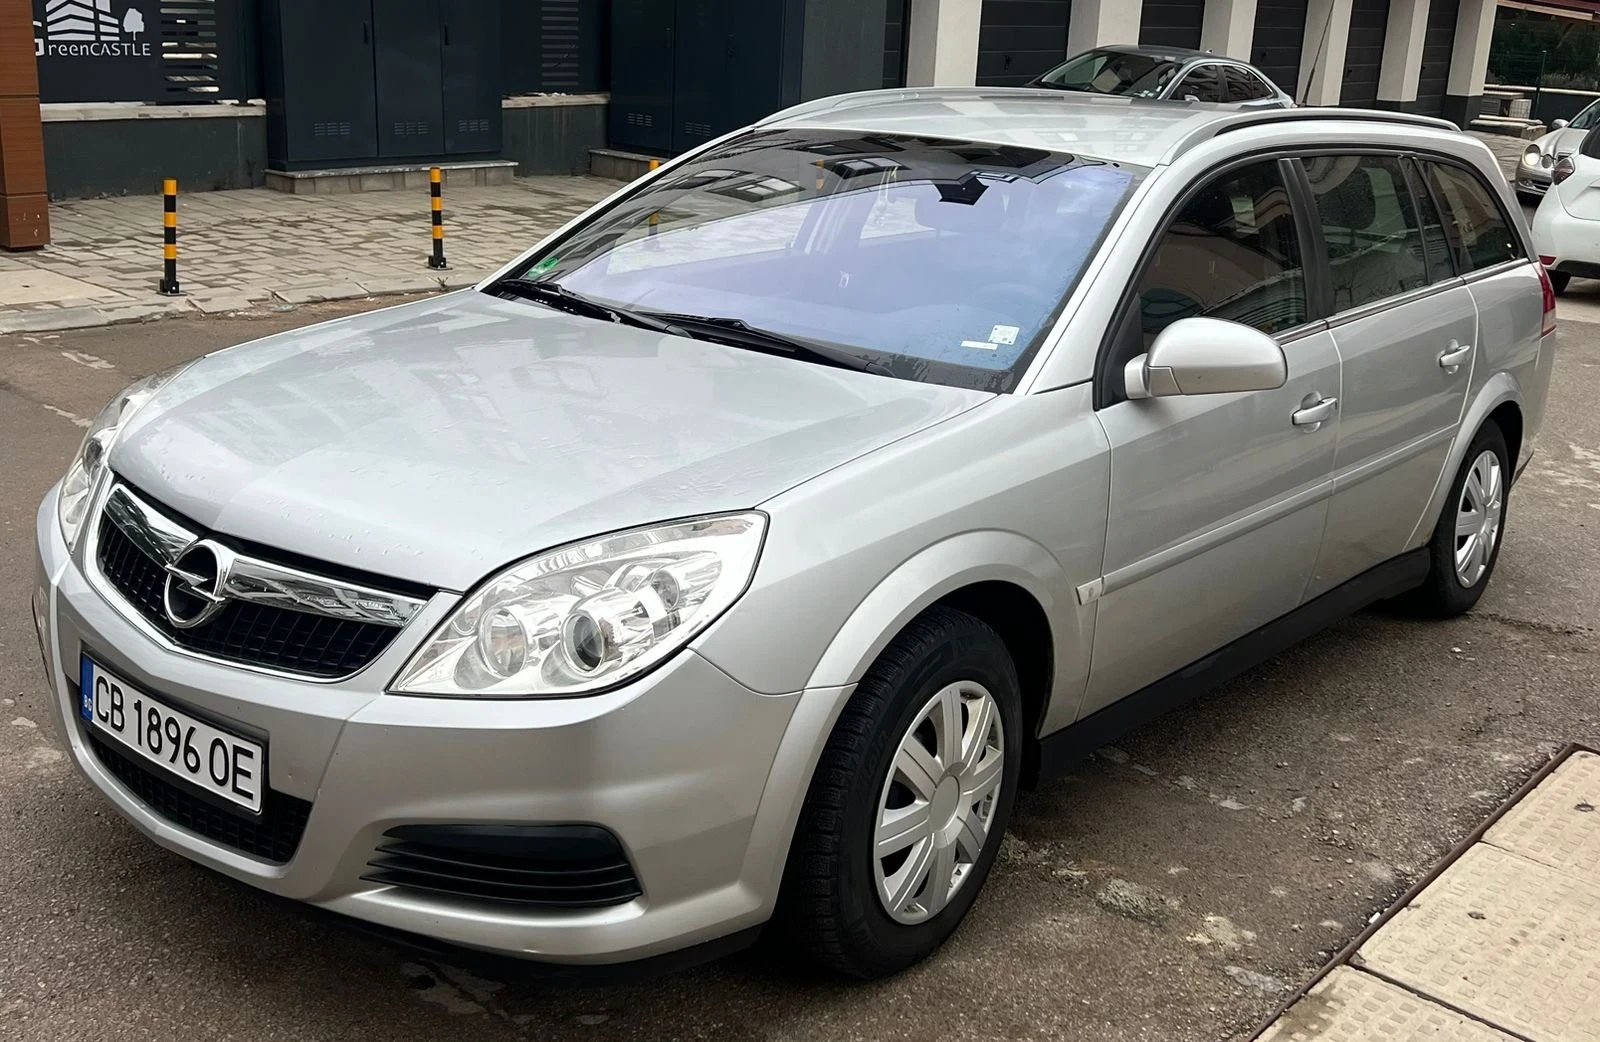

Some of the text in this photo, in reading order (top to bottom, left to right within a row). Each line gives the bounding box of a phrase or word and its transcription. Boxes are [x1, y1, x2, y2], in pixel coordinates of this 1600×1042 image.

[95, 675, 254, 800] CB 1896 OE
